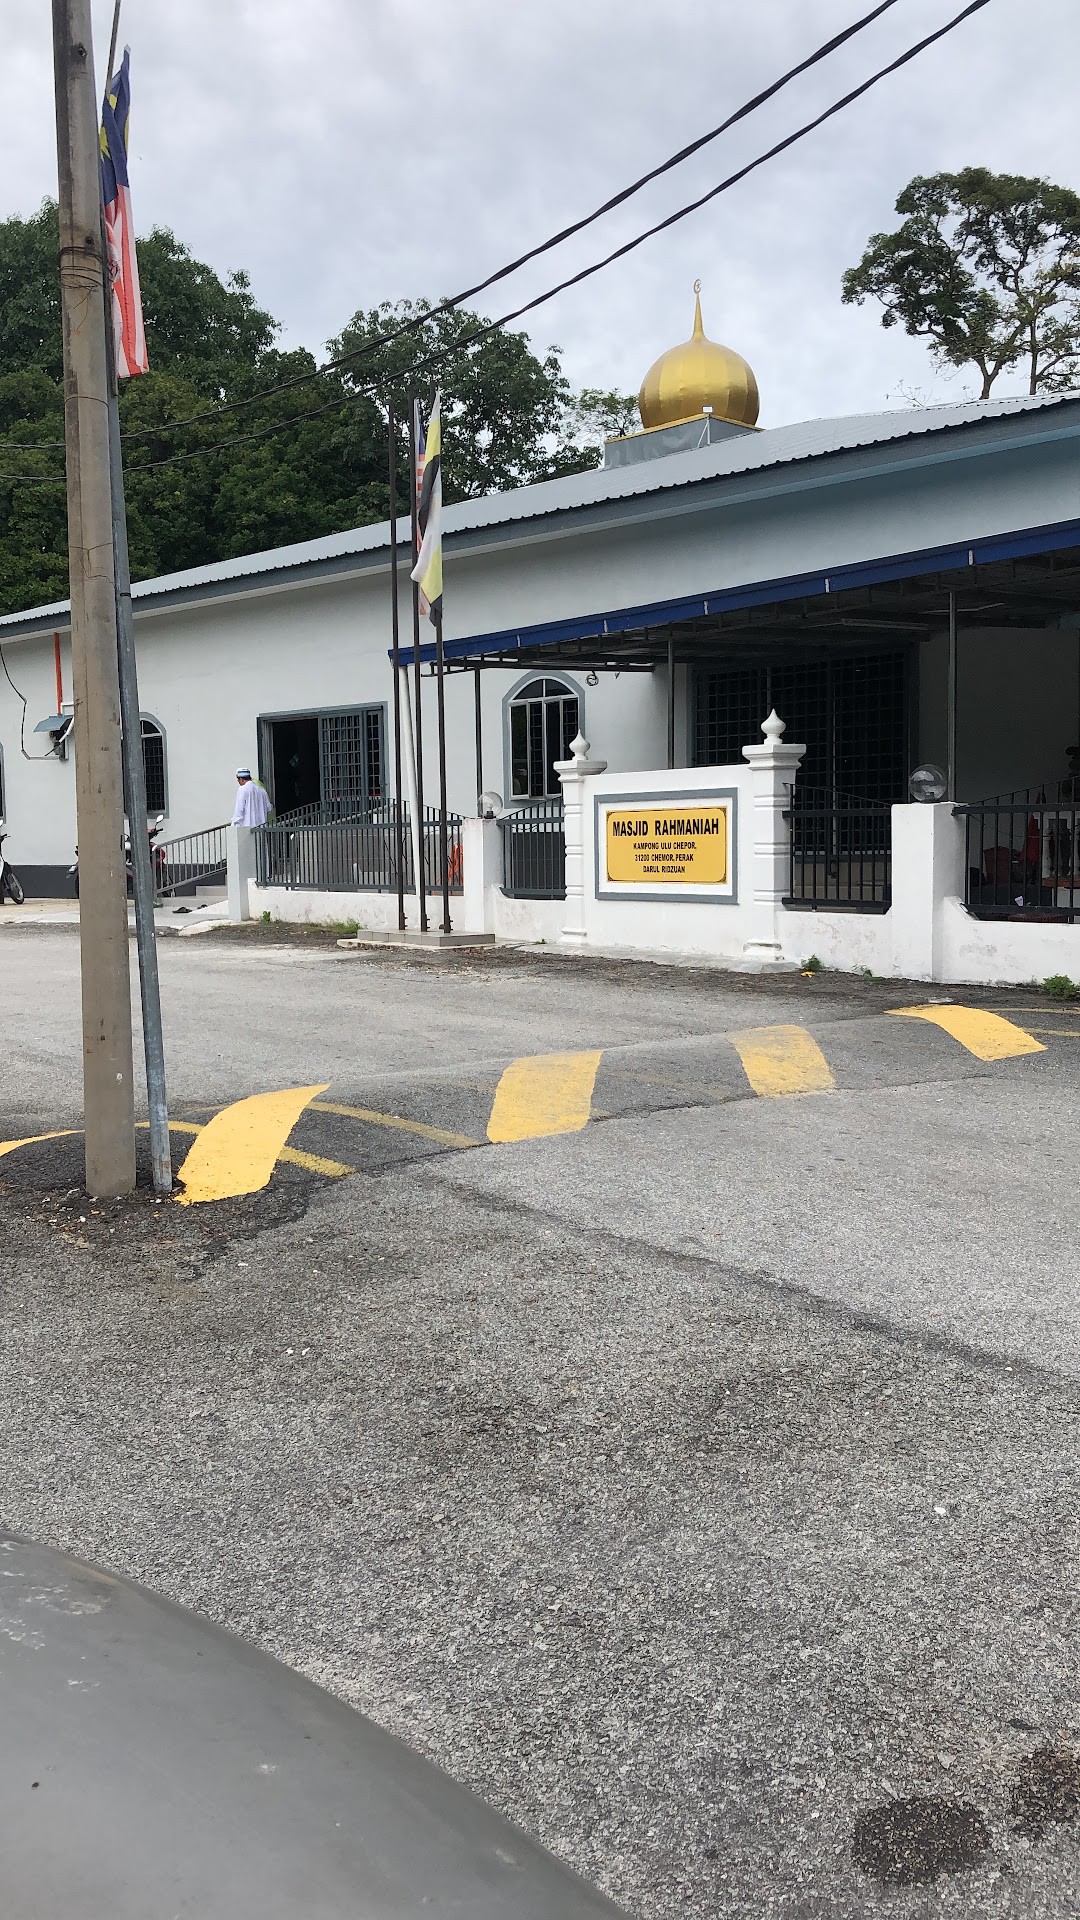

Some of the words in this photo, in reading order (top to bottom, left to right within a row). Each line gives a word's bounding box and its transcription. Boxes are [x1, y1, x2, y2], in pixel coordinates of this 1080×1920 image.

[613, 821, 648, 836] MASJID
[655, 818, 719, 835] RAHMANIAH
[633, 842, 659, 850] KAMPONG
[660, 842, 672, 850] ULU
[634, 854, 649, 862] 31200
[675, 854, 694, 862] PERAK
